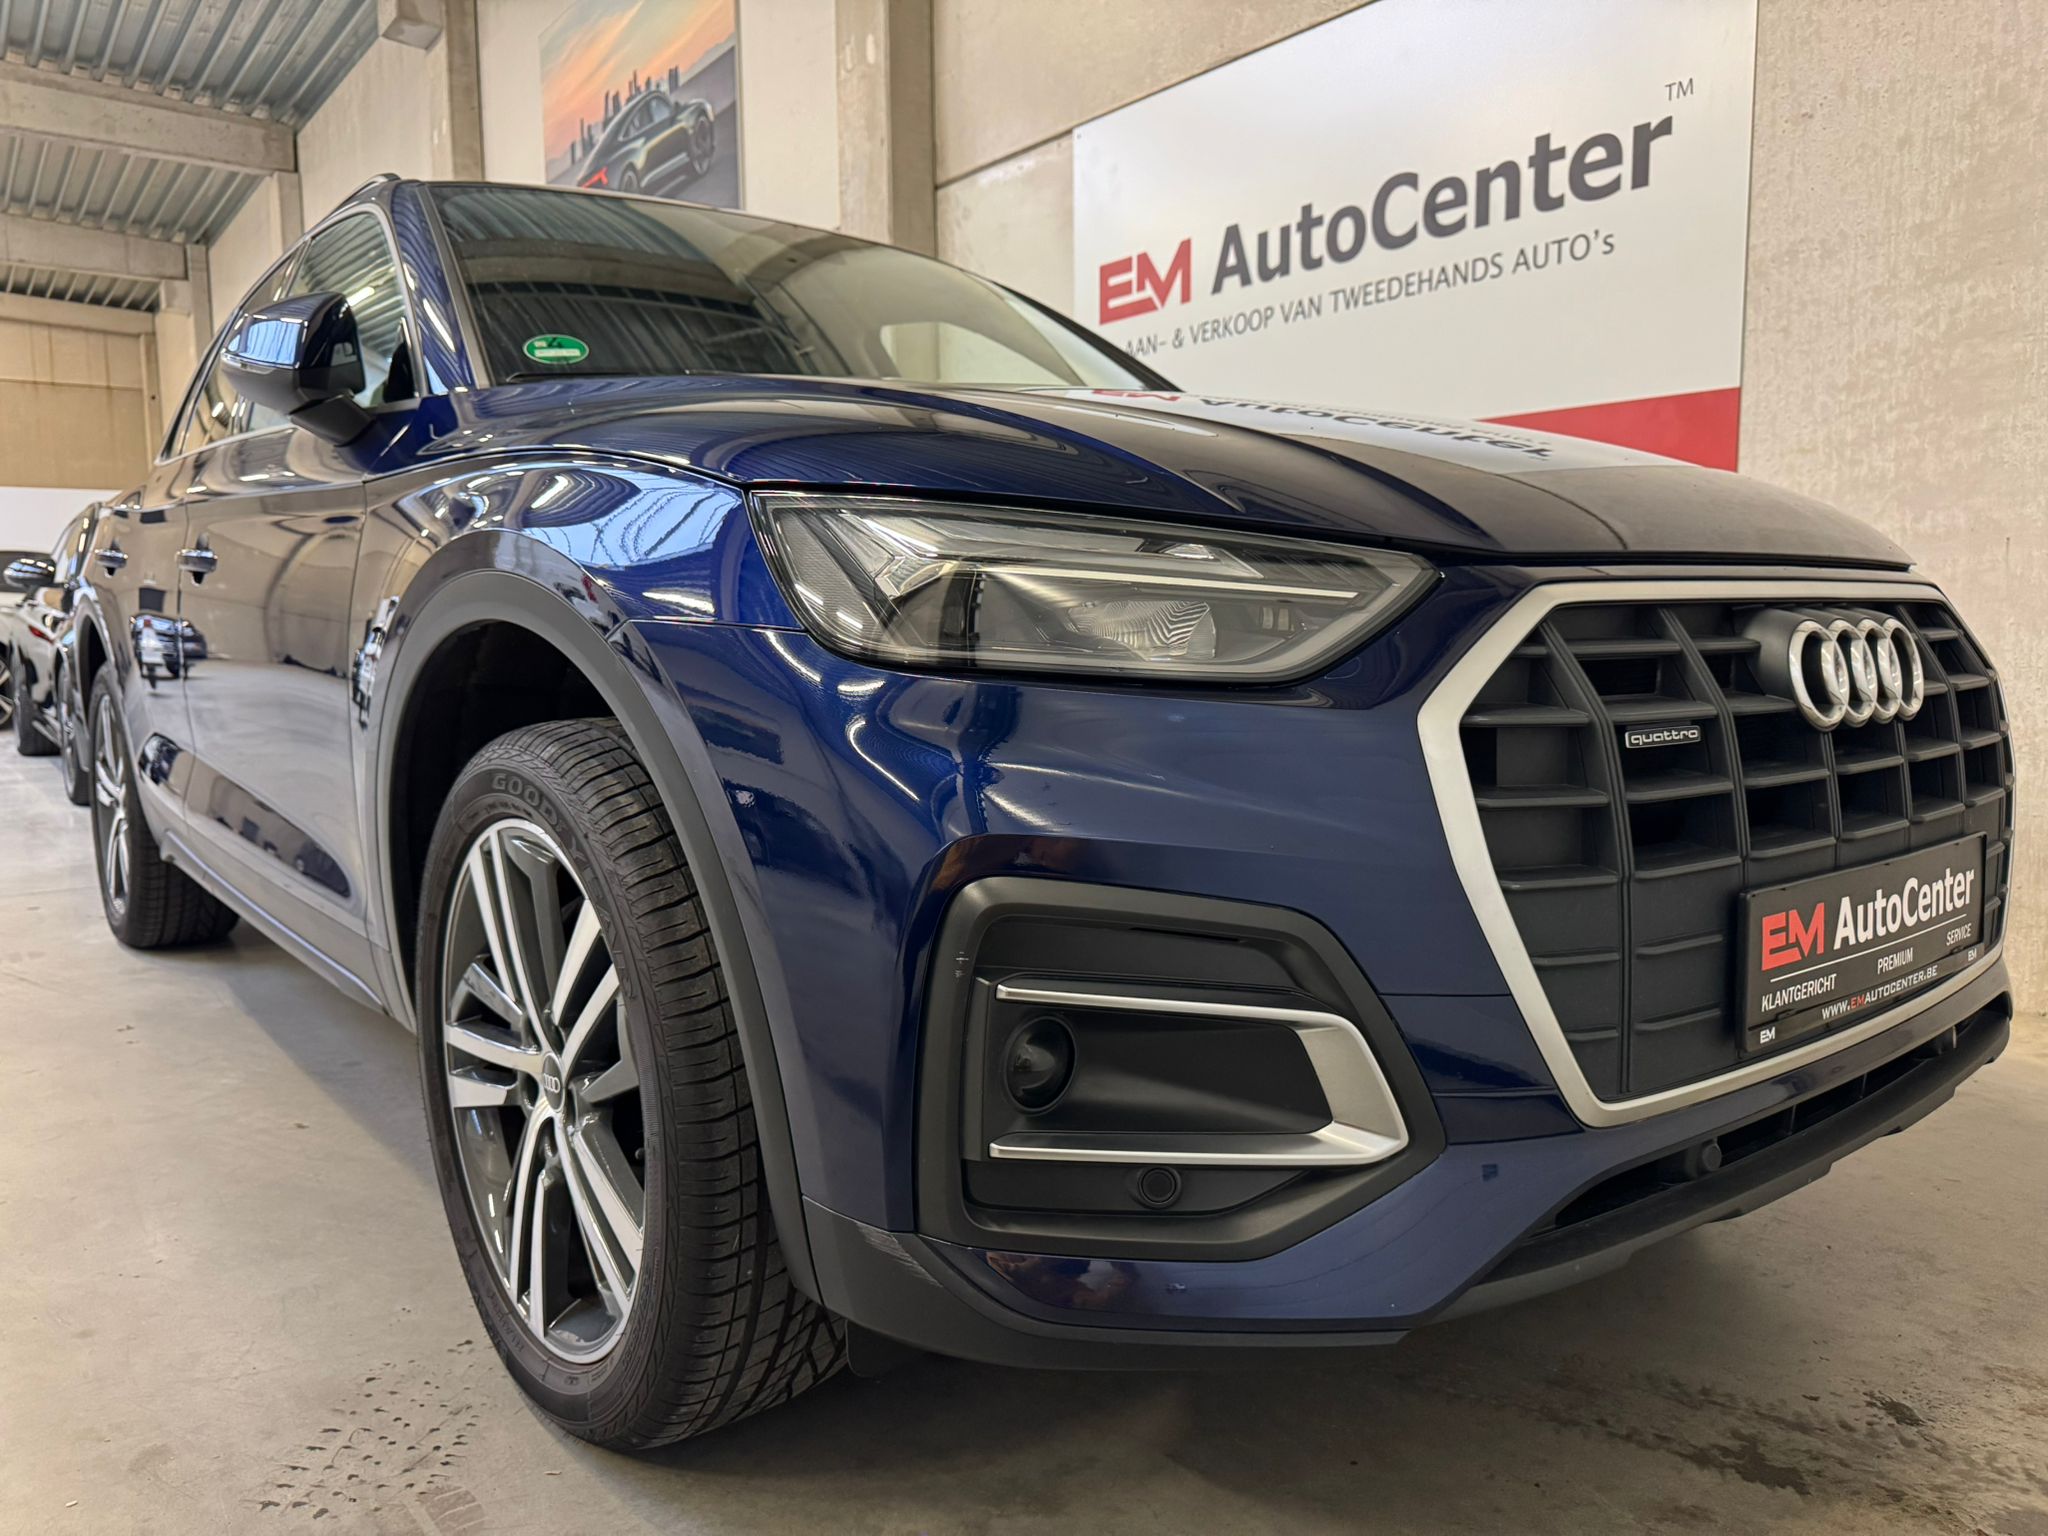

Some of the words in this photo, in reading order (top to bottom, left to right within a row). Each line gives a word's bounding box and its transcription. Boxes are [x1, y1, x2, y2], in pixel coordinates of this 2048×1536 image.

[1665, 77, 1694, 101] TM
[1100, 238, 1191, 325] EM
[1211, 115, 1673, 295] AutoCenter
[1172, 327, 1185, 349] &
[1188, 306, 1275, 345] VERKOOP
[1280, 294, 1323, 324] VAN
[1329, 252, 1504, 313] TWEEDEHANDS
[1631, 729, 1699, 746] quattro
[1761, 902, 1825, 971] EM
[1833, 867, 1975, 950] AutoCenter
[1761, 973, 1837, 1012] KLANTGERICHT
[1877, 947, 1913, 975] PREMIUM
[1946, 922, 1972, 946] SERVICE
[1967, 950, 1978, 962] EM
[1821, 965, 1938, 1020] WWW.EMAUTOCENTER.BE
[1760, 1026, 1776, 1044] EM
